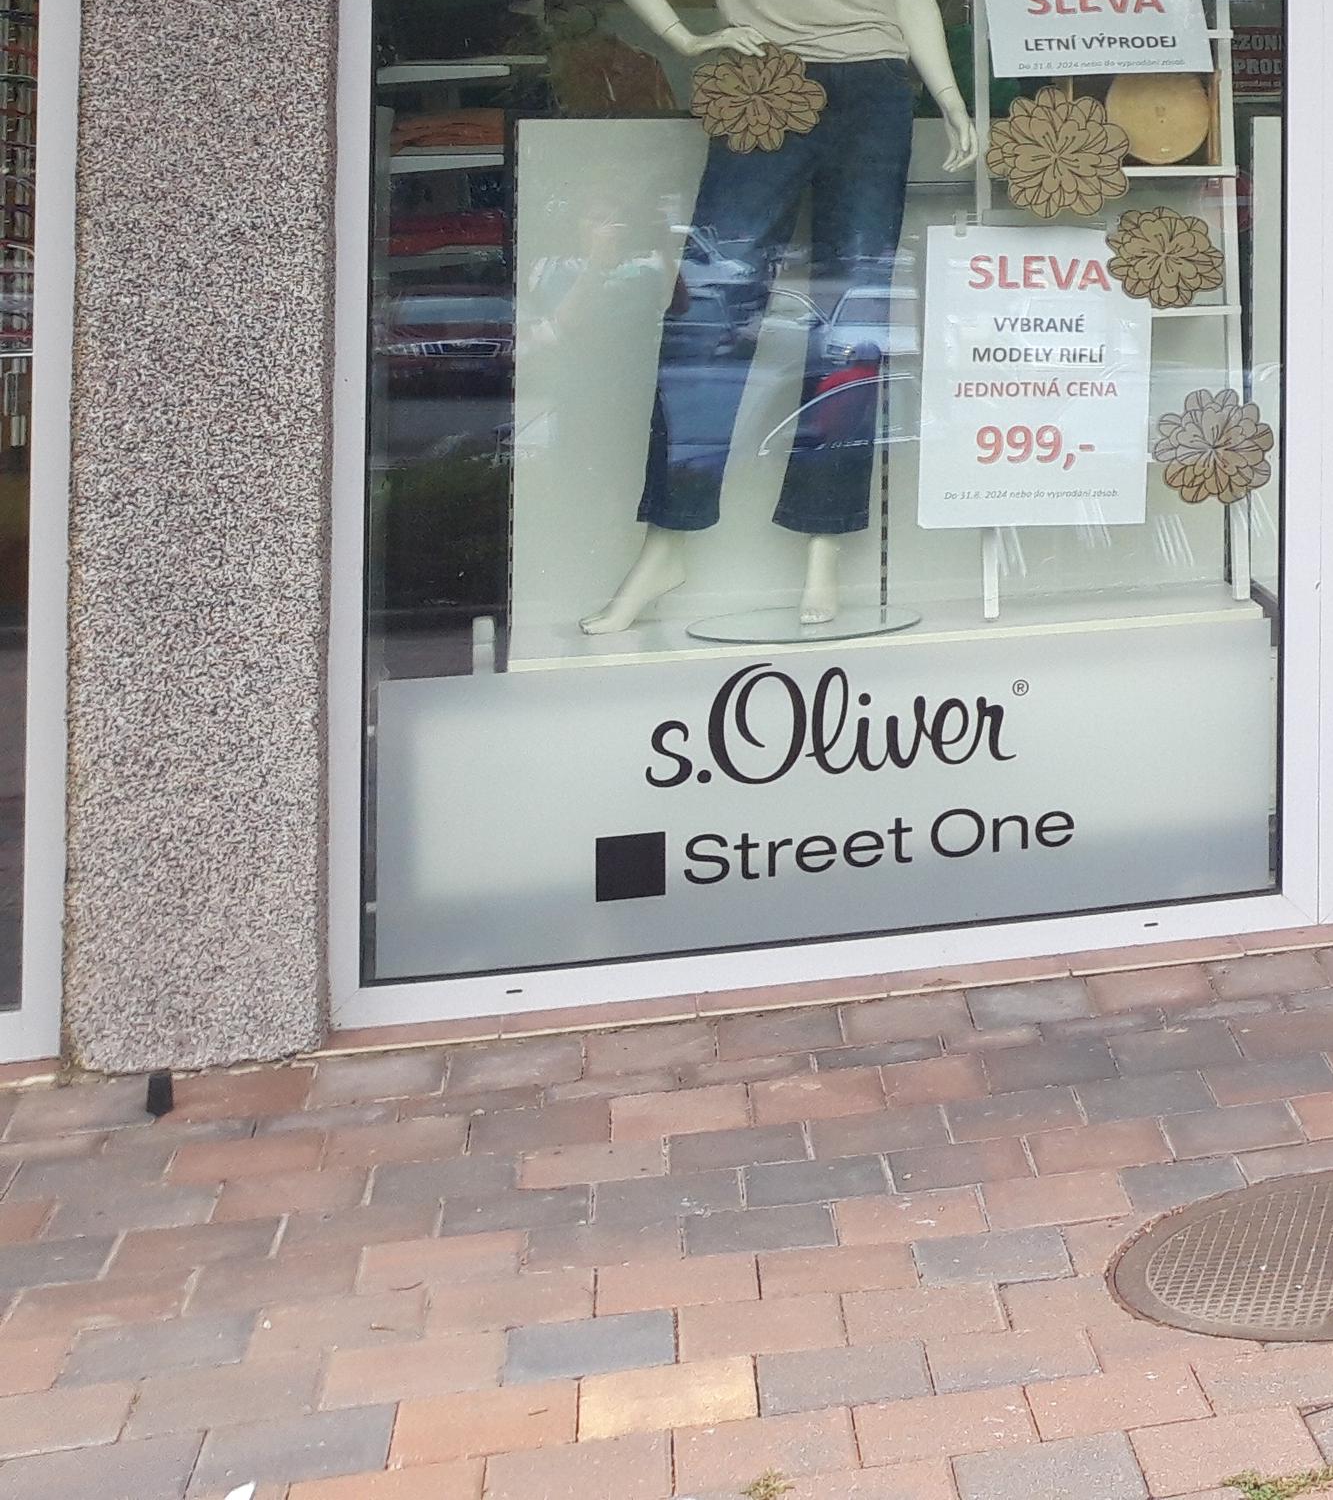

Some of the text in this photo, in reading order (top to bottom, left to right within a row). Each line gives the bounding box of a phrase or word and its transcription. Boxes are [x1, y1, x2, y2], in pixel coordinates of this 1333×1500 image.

[1024, 32, 1177, 52] LETNÍ VÝPRODEJ
[1018, 62, 1031, 70] Do
[968, 255, 1111, 292] SLEVA
[993, 315, 1086, 333] VYBRANÉ
[972, 344, 1106, 363] MODELY RIFLÍ
[954, 378, 1118, 398] JEDNOTNÁ CENA
[976, 425, 1095, 470] 999,-
[944, 491, 957, 500] Do
[985, 490, 1008, 499] 2024
[1009, 490, 1032, 498] nebo
[1033, 490, 1045, 498] do
[1047, 489, 1091, 499] vyprodání
[645, 662, 1017, 788] s.Oliver
[681, 806, 1075, 887] Street One
